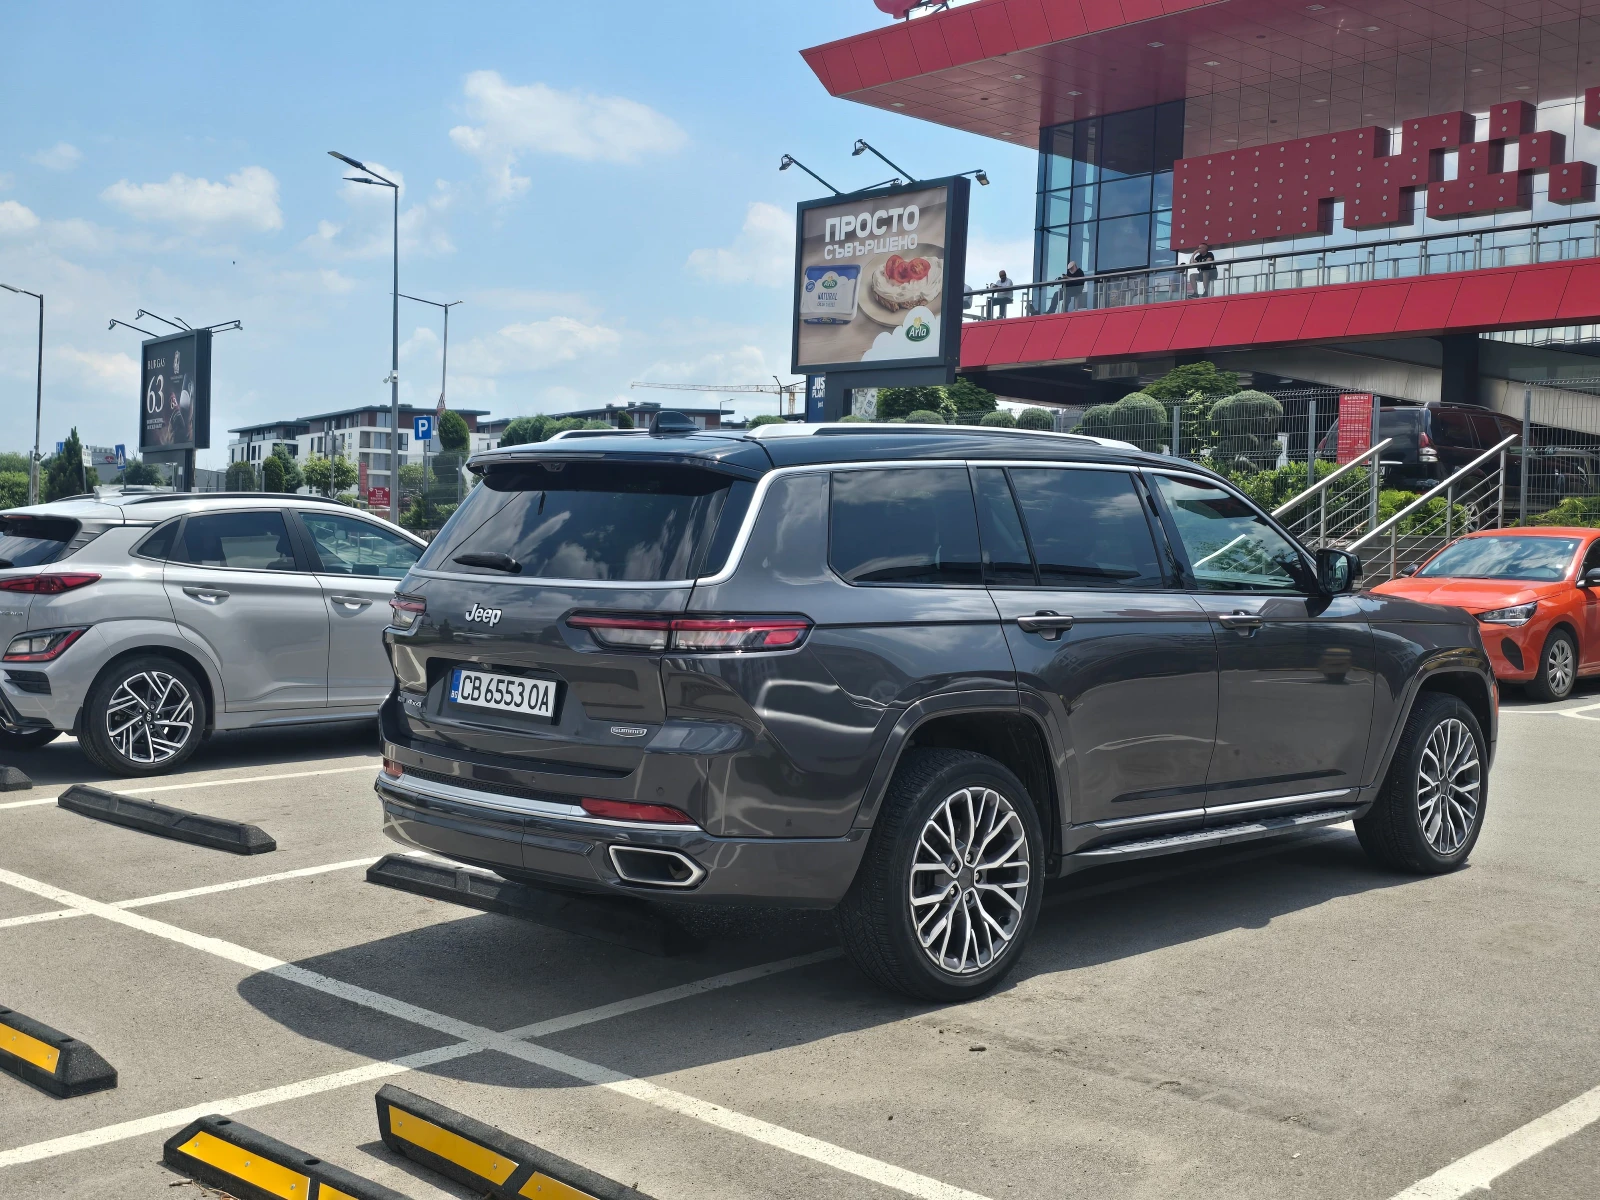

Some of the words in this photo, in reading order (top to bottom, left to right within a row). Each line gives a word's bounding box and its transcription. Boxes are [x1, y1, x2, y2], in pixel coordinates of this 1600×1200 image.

[824, 204, 920, 242] ПРОСТО
[824, 233, 918, 260] СЪВЪРШЕНО
[908, 325, 927, 338] Arla
[147, 375, 164, 413] 63
[418, 419, 429, 438] P
[465, 603, 502, 627] Jeep
[460, 674, 483, 701] CB
[484, 677, 526, 708] 6553
